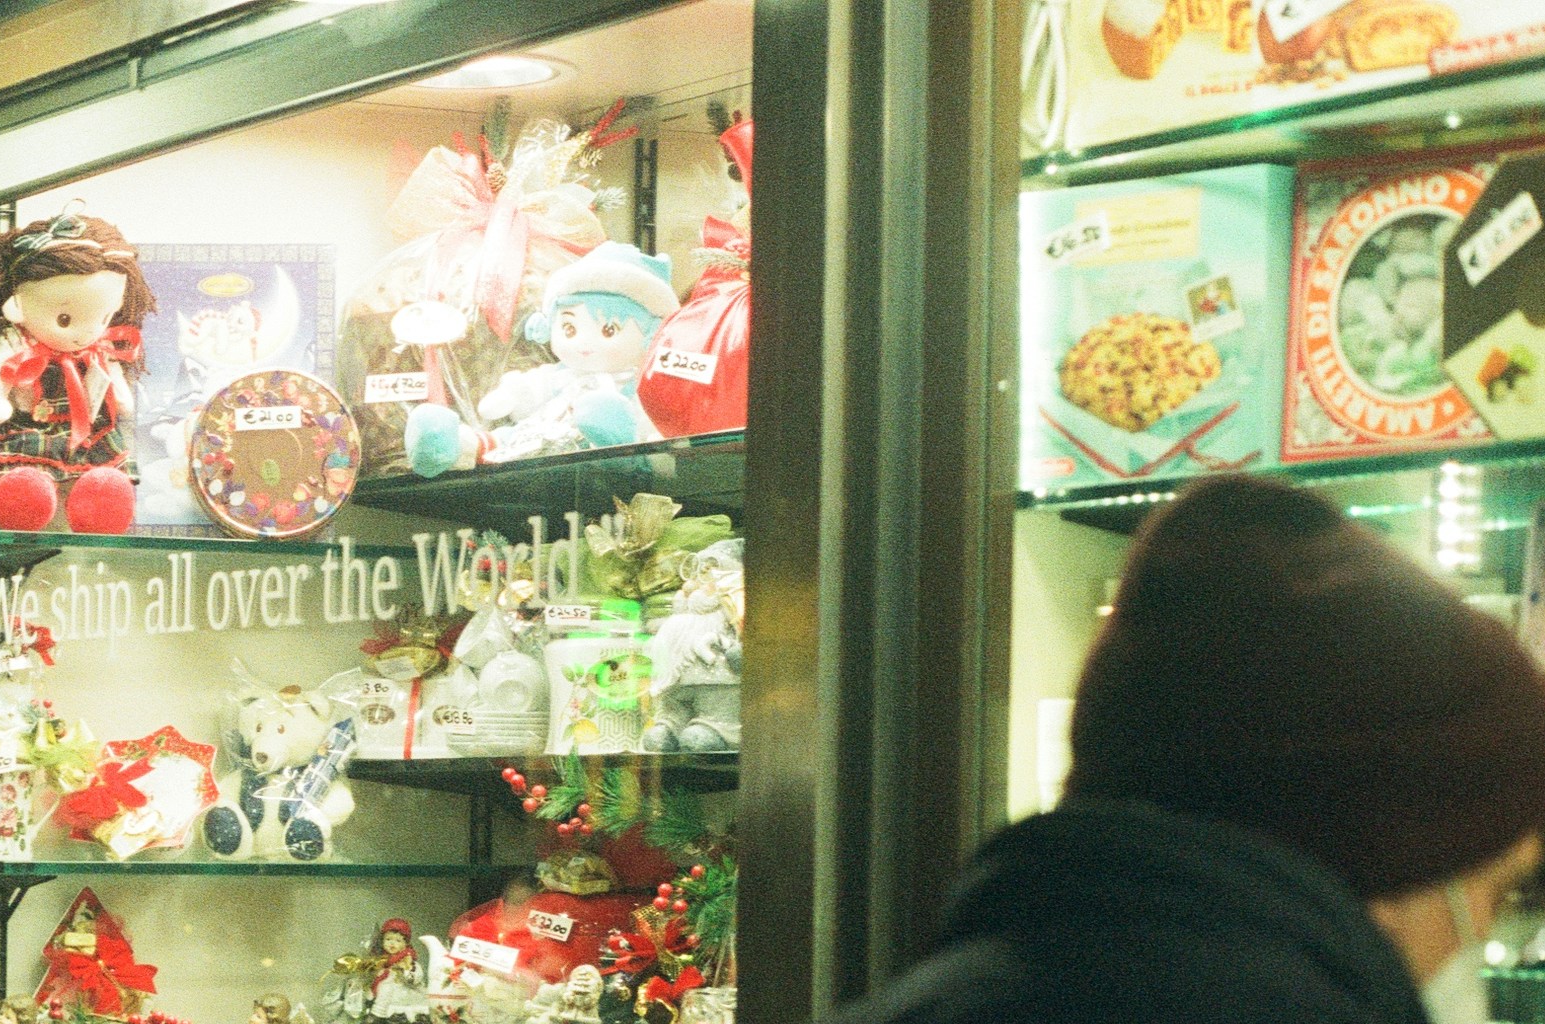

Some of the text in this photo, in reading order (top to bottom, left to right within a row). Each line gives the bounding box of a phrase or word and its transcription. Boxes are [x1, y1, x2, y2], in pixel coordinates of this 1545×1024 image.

[1306, 174, 1451, 434] AMARETTI DI SARONNO
[51, 561, 134, 660] ship
[144, 552, 194, 634] all
[207, 562, 313, 631] over
[321, 535, 399, 624] the
